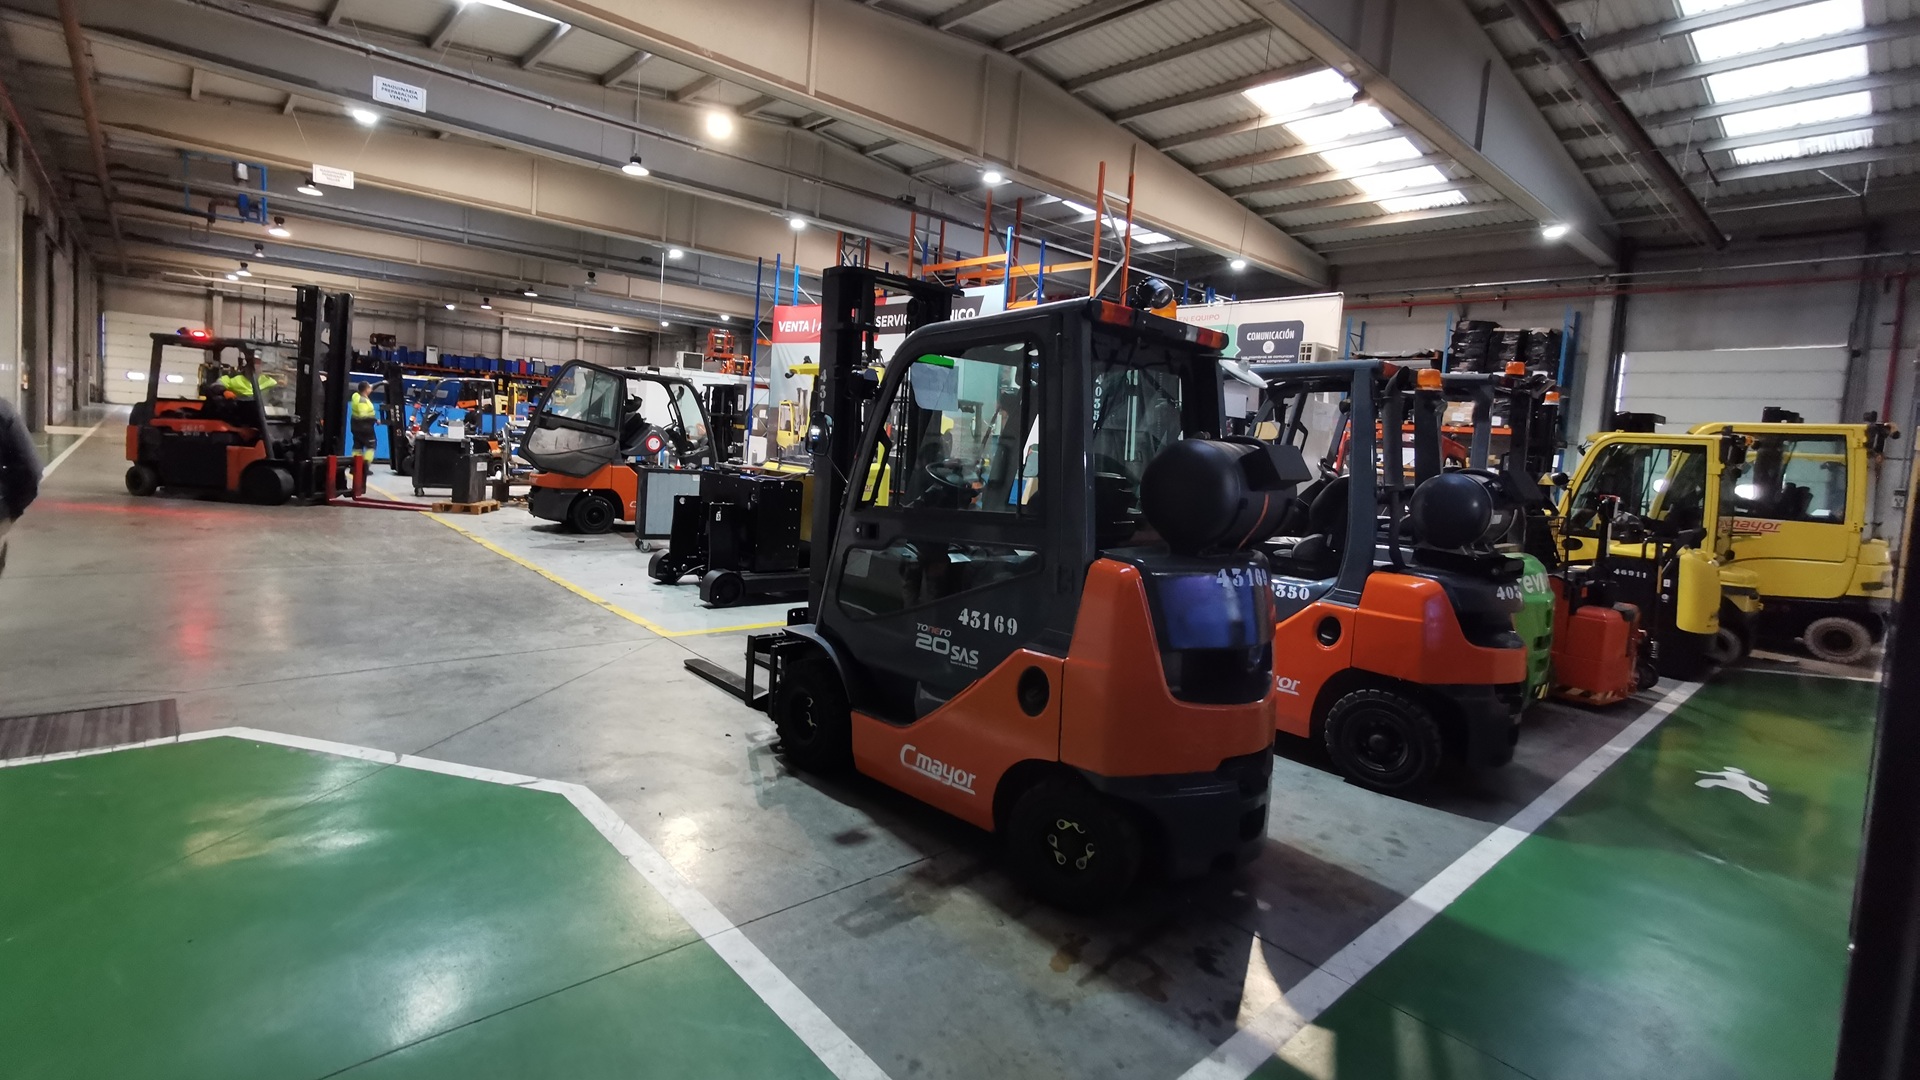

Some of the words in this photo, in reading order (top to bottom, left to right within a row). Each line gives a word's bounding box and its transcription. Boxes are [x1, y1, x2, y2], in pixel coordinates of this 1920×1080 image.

[778, 320, 809, 333] VENTA
[1190, 313, 1220, 322] EQUIPO
[1246, 328, 1294, 341] COMUNICACIÓN
[1216, 568, 1268, 587] 43169
[958, 608, 1018, 636] 43169
[915, 632, 950, 655] 20
[950, 646, 979, 665] SAS
[900, 744, 976, 795] Cmayor
